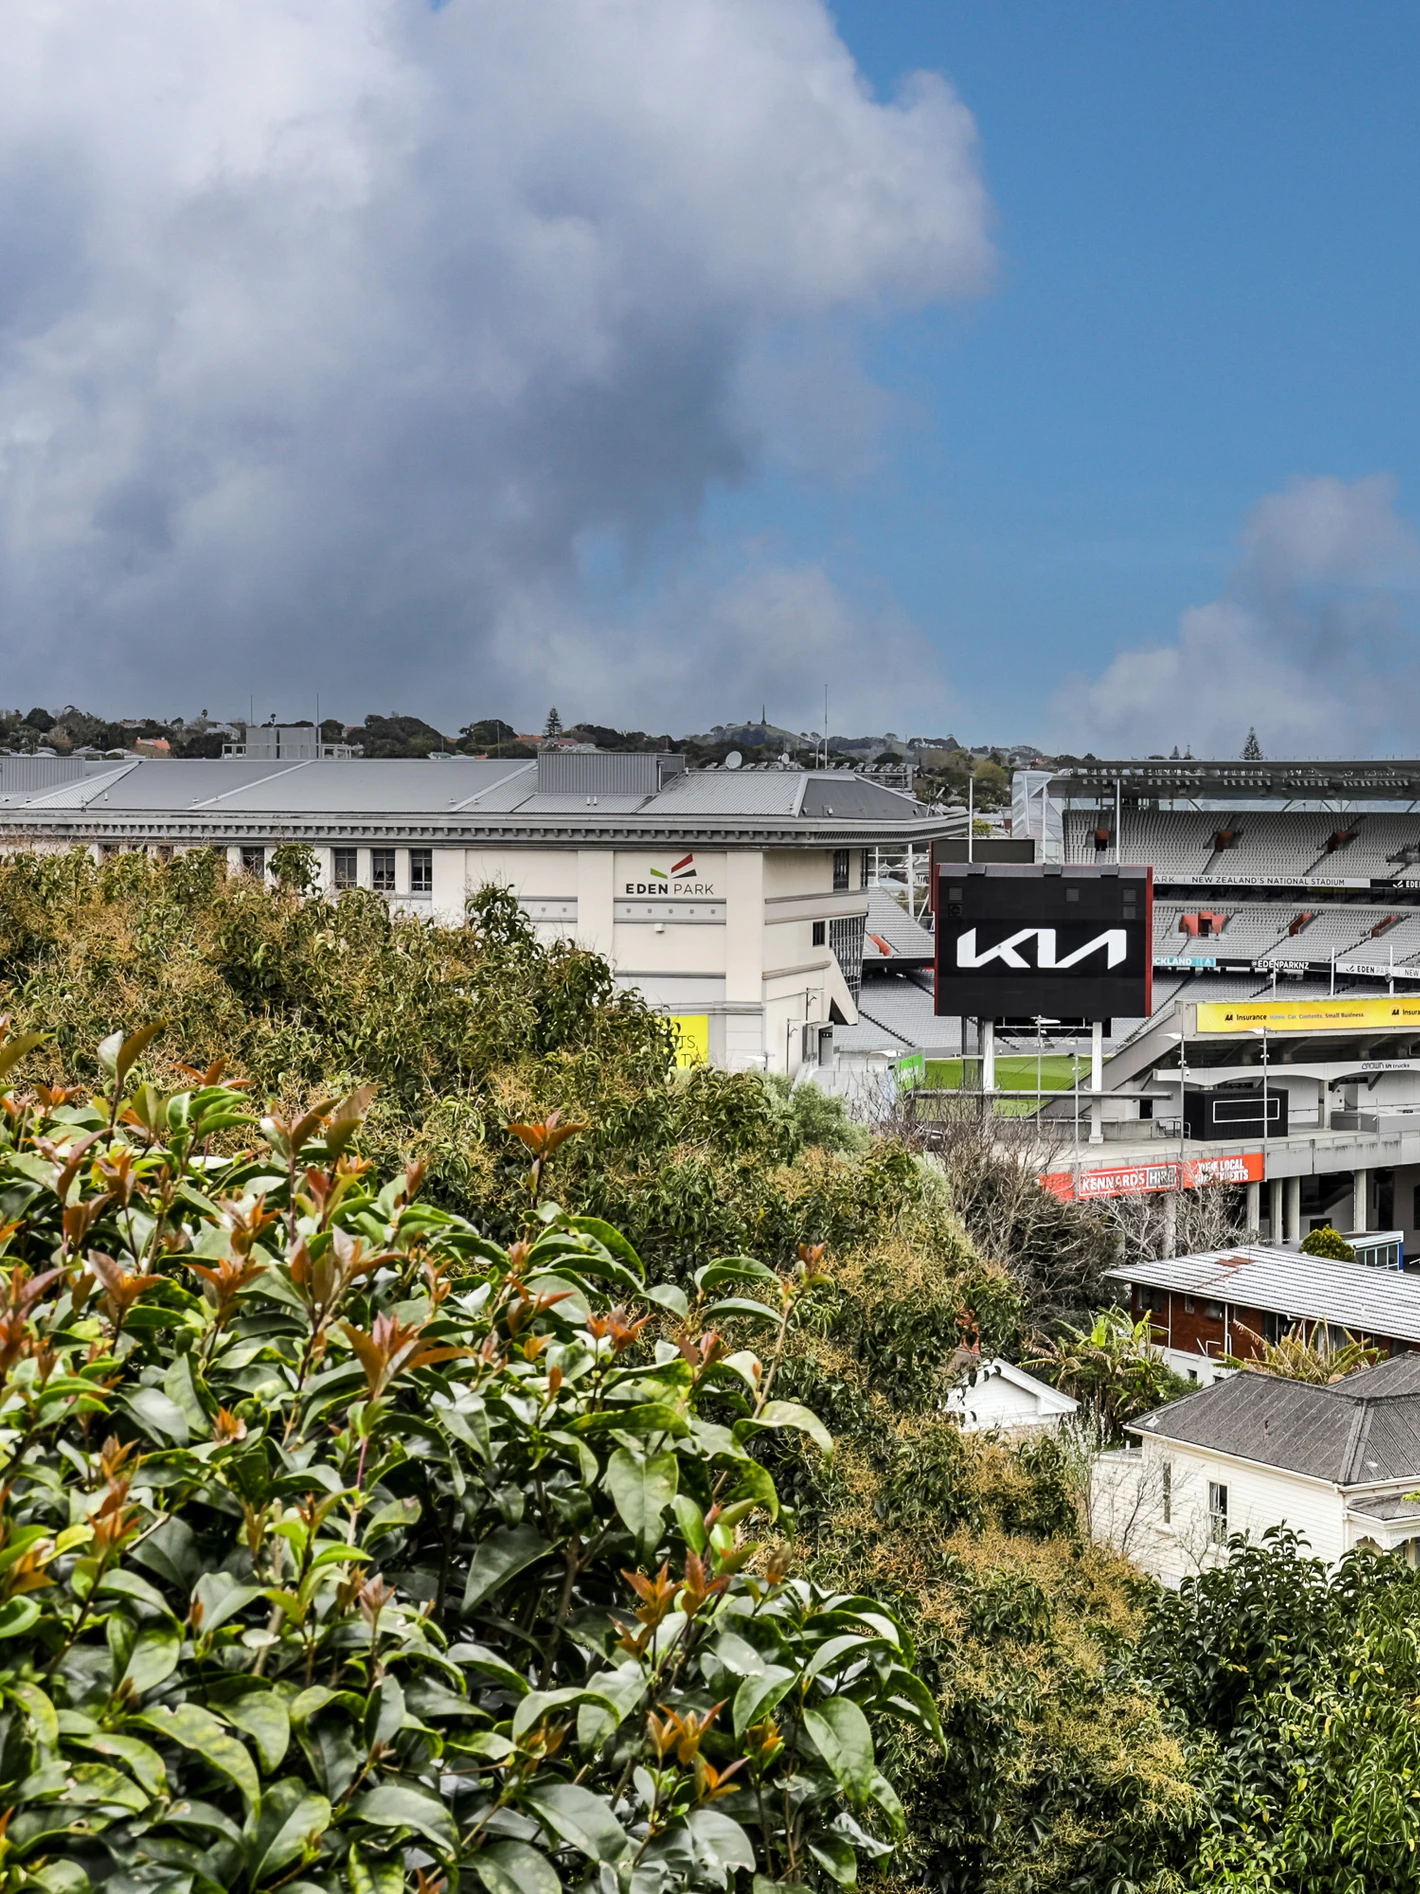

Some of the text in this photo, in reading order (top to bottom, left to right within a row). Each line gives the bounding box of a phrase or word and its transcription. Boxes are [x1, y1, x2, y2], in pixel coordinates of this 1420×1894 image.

[1153, 875, 1345, 886] ARK NEW ZEALAND'S NATIONAL STADIUM
[625, 883, 714, 895] EDEN PARK
[956, 927, 1127, 970] KIA
[1152, 957, 1193, 966] CKLAND
[1357, 965, 1375, 974] EDEN
[1404, 969, 1419, 977] NEW
[1219, 1158, 1245, 1172] LOCAL
